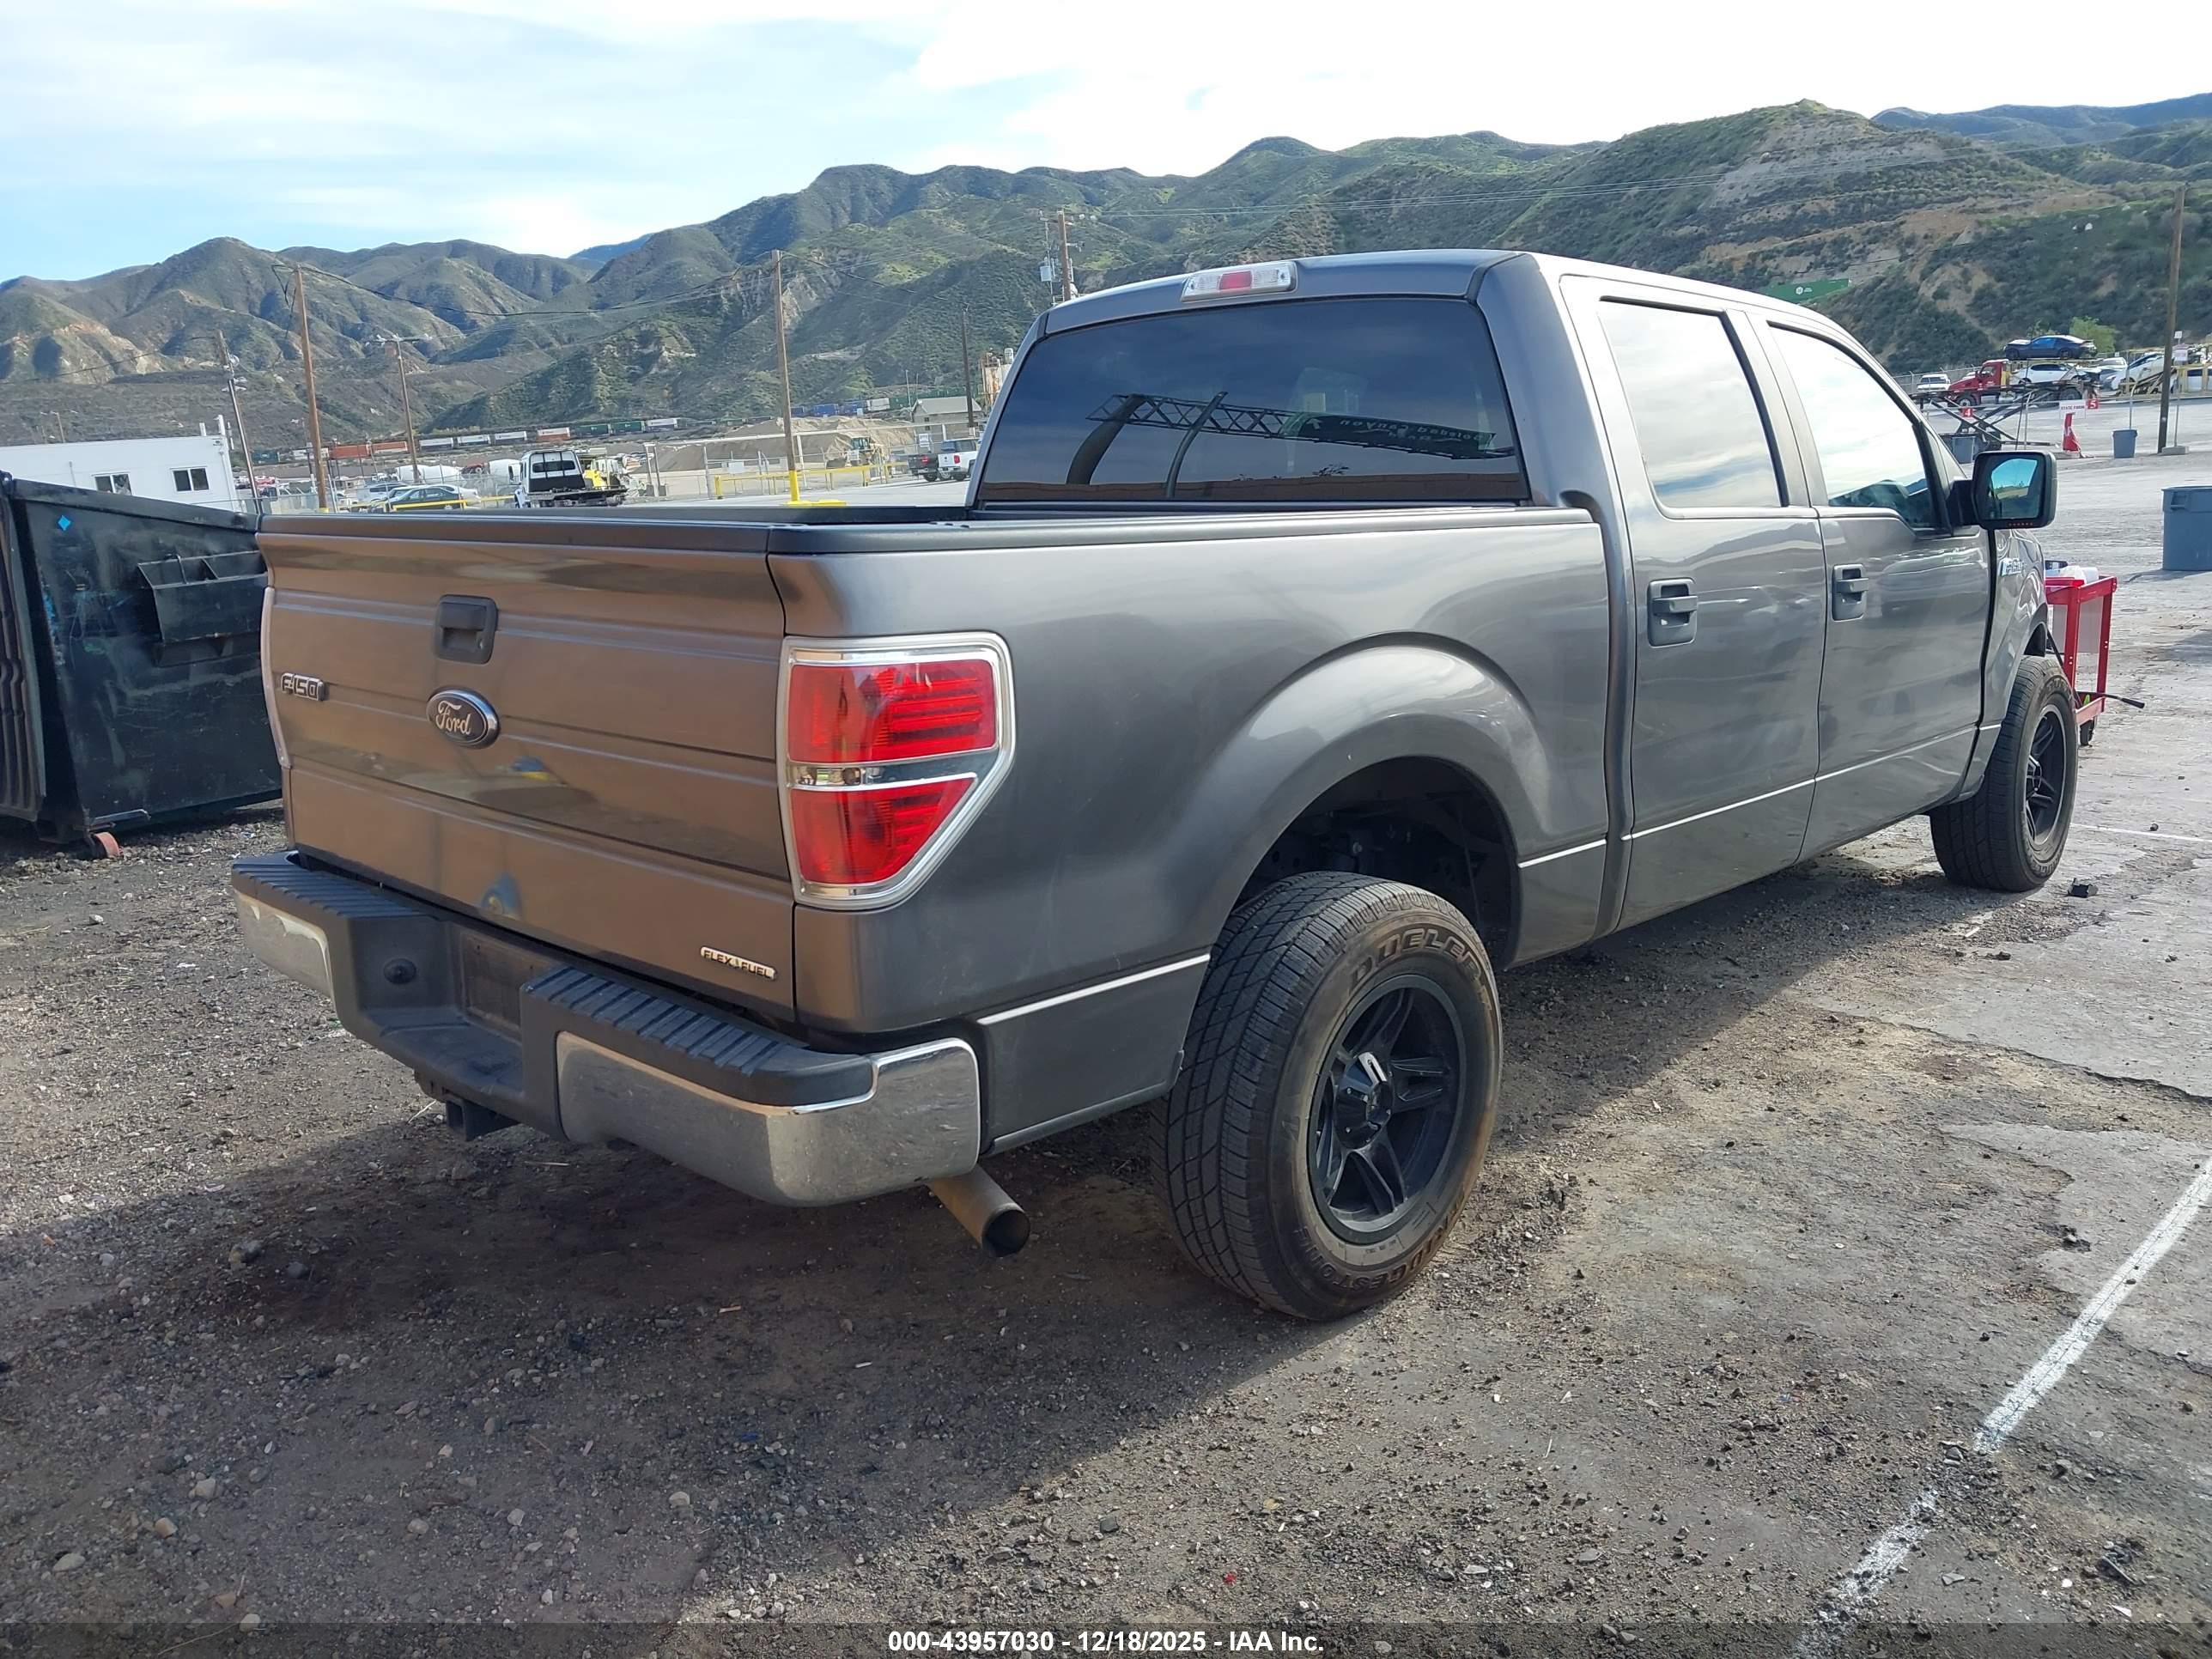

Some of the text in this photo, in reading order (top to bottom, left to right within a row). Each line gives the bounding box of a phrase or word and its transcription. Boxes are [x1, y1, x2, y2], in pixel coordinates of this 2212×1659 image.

[1964, 408, 1971, 416] 4
[2089, 399, 2097, 409] 5
[436, 700, 471, 735] Ford
[702, 949, 774, 979] FLEX FUEL
[1293, 1209, 1458, 1288] IDGESTONE
